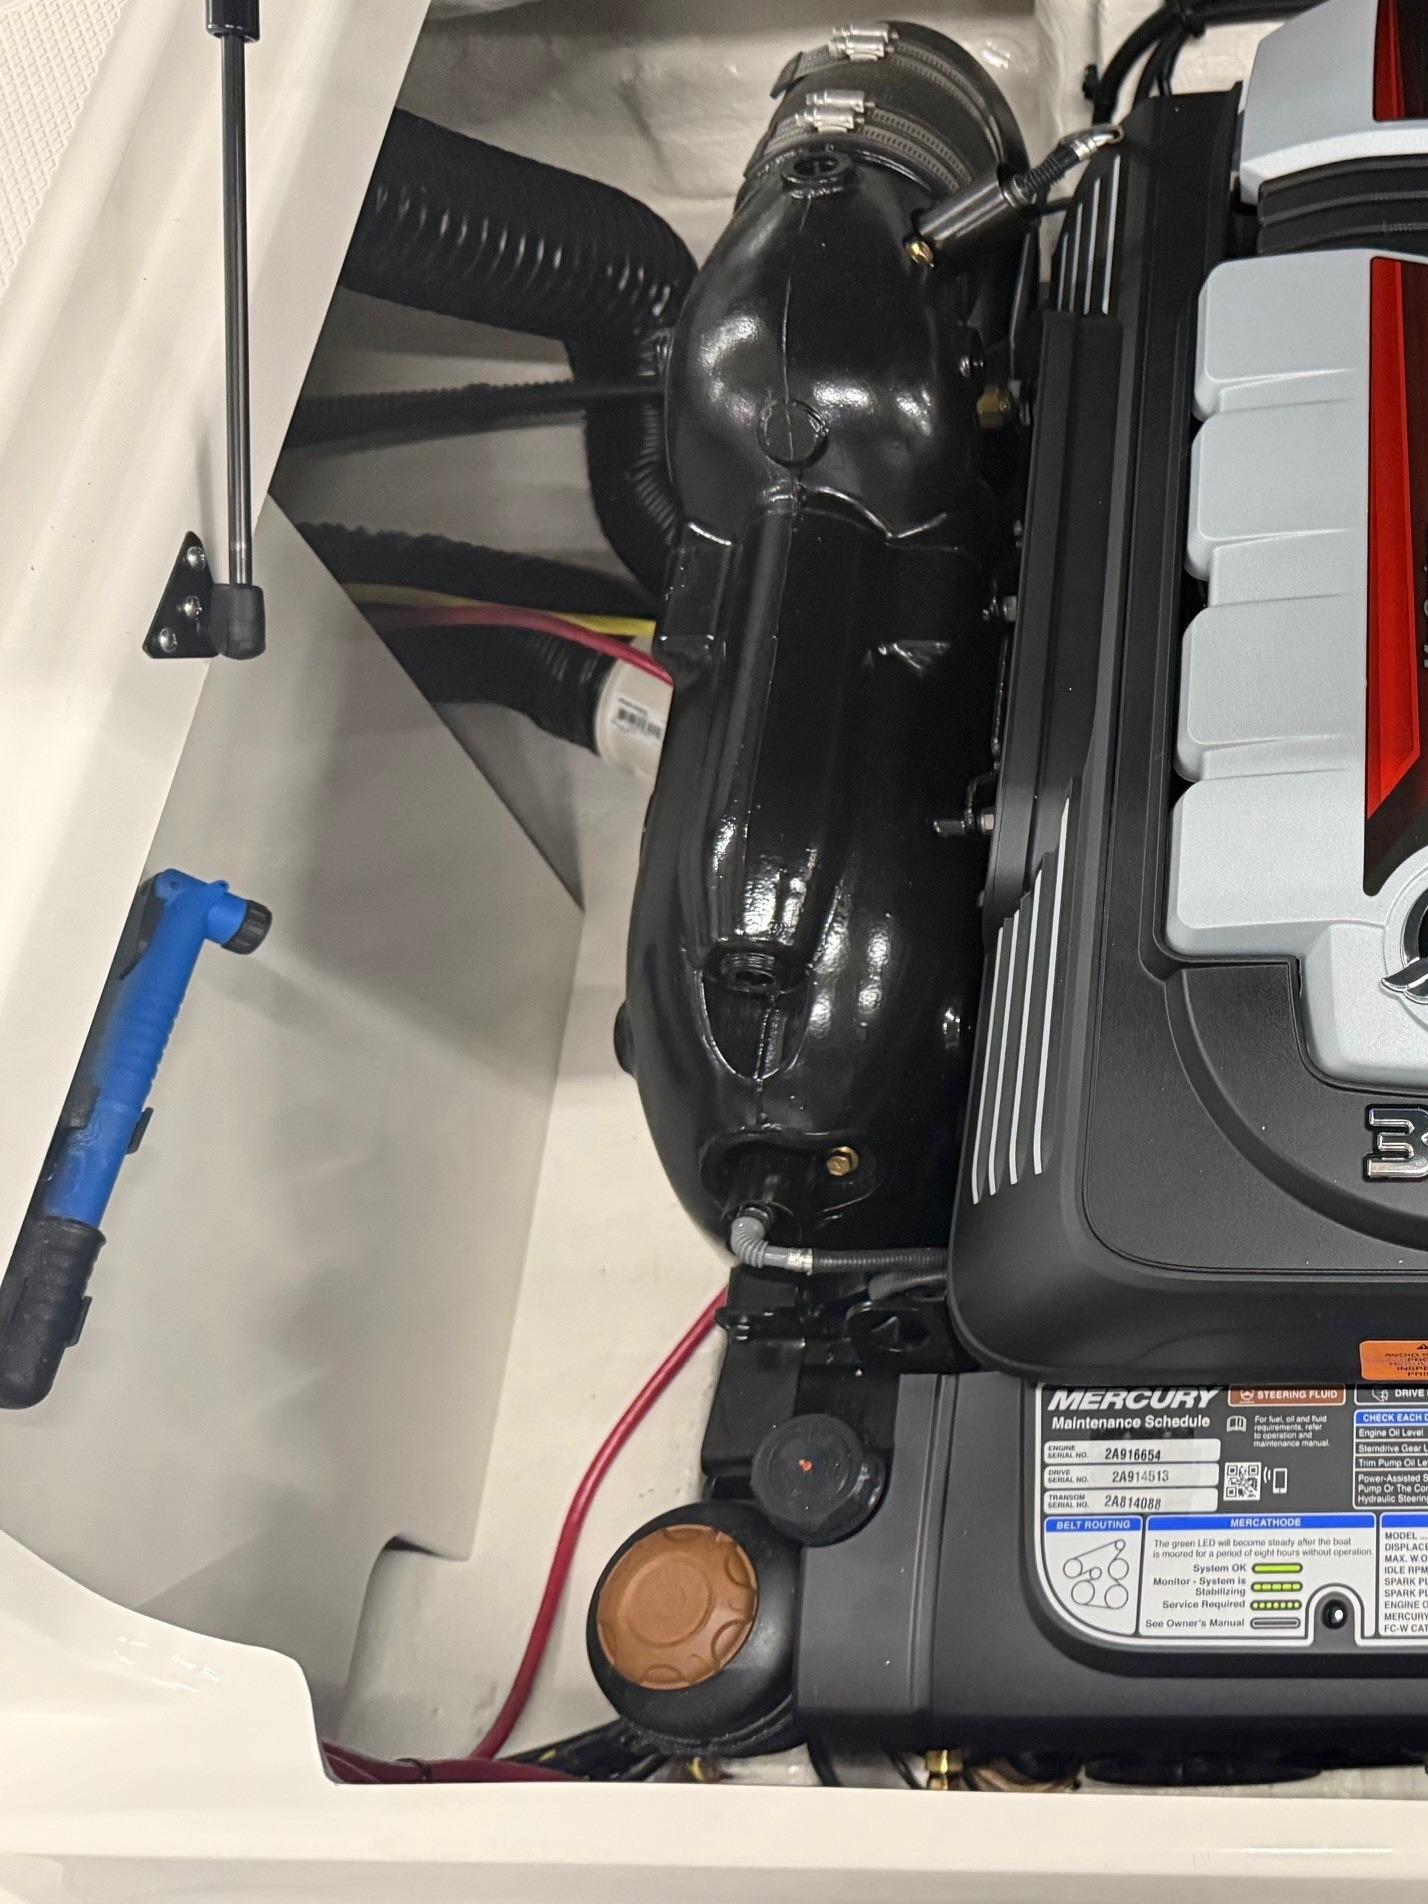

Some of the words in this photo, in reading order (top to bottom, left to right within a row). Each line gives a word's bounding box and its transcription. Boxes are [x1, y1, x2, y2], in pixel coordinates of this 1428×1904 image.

[1258, 1390, 1306, 1399] STEERING
[1310, 1390, 1338, 1398] FLUID
[1395, 1388, 1424, 1397] DRIVE
[1048, 1388, 1222, 1410] MERCURY
[1052, 1416, 1141, 1429] Maintenance
[1145, 1415, 1210, 1428] Schedule
[1363, 1413, 1394, 1422] CHECK
[1397, 1413, 1422, 1421] EACH
[1359, 1429, 1386, 1438] Engine
[1389, 1428, 1399, 1437] Oil
[1402, 1428, 1423, 1436] Level
[1359, 1444, 1399, 1452] Sterndrive
[1402, 1444, 1421, 1452] Gear
[1105, 1448, 1161, 1461] 2A916654
[1359, 1459, 1376, 1467] Trim
[1378, 1459, 1401, 1469] Pump
[1112, 1470, 1169, 1483] 2A914513
[1359, 1474, 1420, 1483] Power-Assisted
[1359, 1484, 1381, 1493] Pump
[1384, 1485, 1394, 1493] Or
[1396, 1484, 1411, 1492] The
[1104, 1495, 1161, 1510] 2A814088
[1358, 1496, 1395, 1504] Hydraulic
[1057, 1521, 1082, 1530] BELT
[1085, 1520, 1130, 1529] ROUTING
[1231, 1519, 1301, 1527] MERCATHODE
[1172, 1541, 1195, 1549] green
[1198, 1539, 1215, 1547] LED
[1268, 1539, 1294, 1547] steady
[1333, 1537, 1351, 1545] boat
[1153, 1550, 1159, 1558] is
[1216, 1550, 1242, 1559] period
[1255, 1550, 1274, 1558] eight
[1334, 1549, 1373, 1558] operation.
[1193, 1564, 1229, 1574] System
[1232, 1564, 1246, 1572] OK
[1385, 1566, 1405, 1574] IDLE
[1408, 1566, 1428, 1574] RPM
[1153, 1578, 1190, 1586] Monitor
[1199, 1577, 1235, 1586] System
[1196, 1588, 1246, 1597] Stabilizing
[1385, 1589, 1415, 1597] SPARK
[1202, 1600, 1245, 1610] Required
[1167, 1619, 1206, 1627] Owner's
